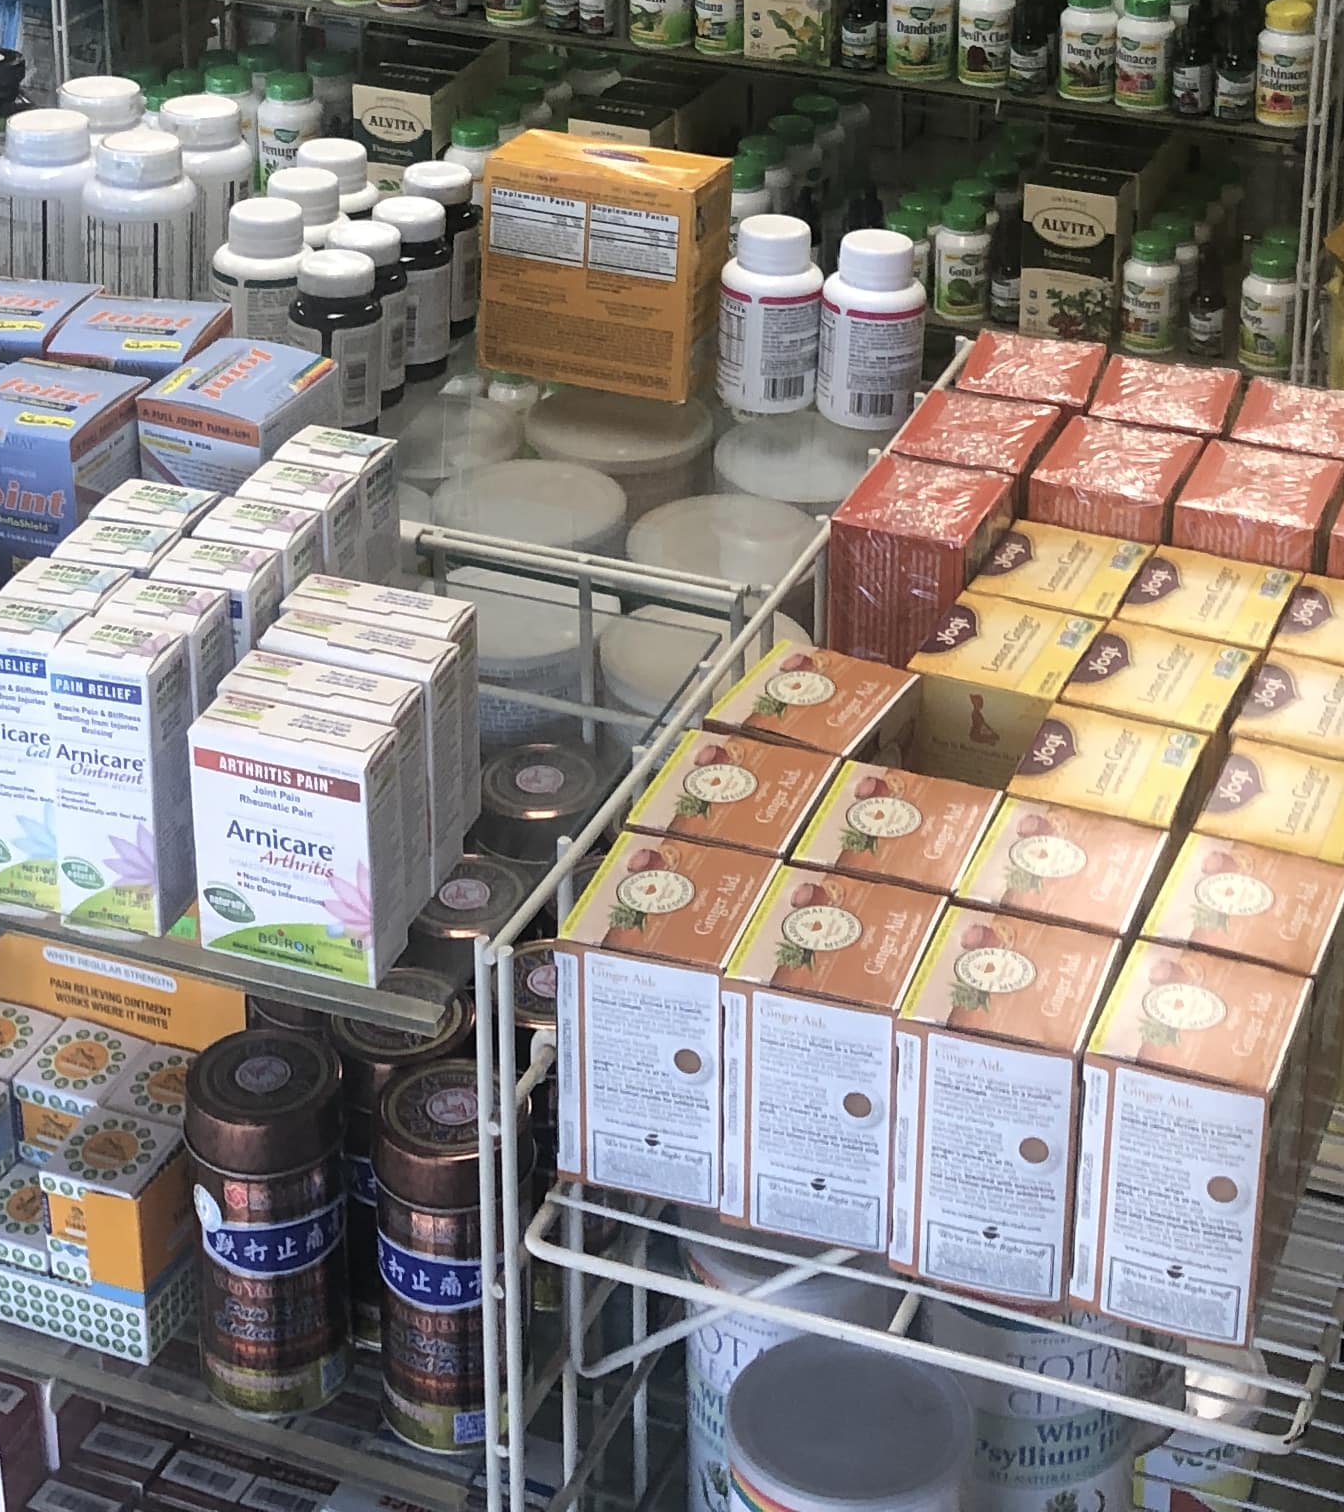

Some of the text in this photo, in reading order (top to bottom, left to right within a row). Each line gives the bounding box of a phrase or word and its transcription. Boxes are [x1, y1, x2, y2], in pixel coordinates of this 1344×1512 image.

[896, 20, 947, 34] Dandelion
[1068, 43, 1091, 58] Dong
[370, 115, 416, 133] ALVITA
[1041, 217, 1096, 238] ALVITA
[56, 677, 131, 700] PAIN RELIEF
[26, 744, 51, 759] Gel
[56, 743, 143, 772] Arnicare
[70, 762, 144, 785] Ointment
[219, 756, 329, 793] ARTHRITIS PAIN
[253, 785, 300, 803] Joint Pain
[240, 794, 313, 818] Rheumatic Pain
[227, 820, 333, 861] Arnicare
[260, 851, 334, 878] Arthritis
[50, 977, 172, 1016] PAIN RELIEVING OINTMENT
[55, 992, 168, 1030] WORKS WHERE IT HURTS
